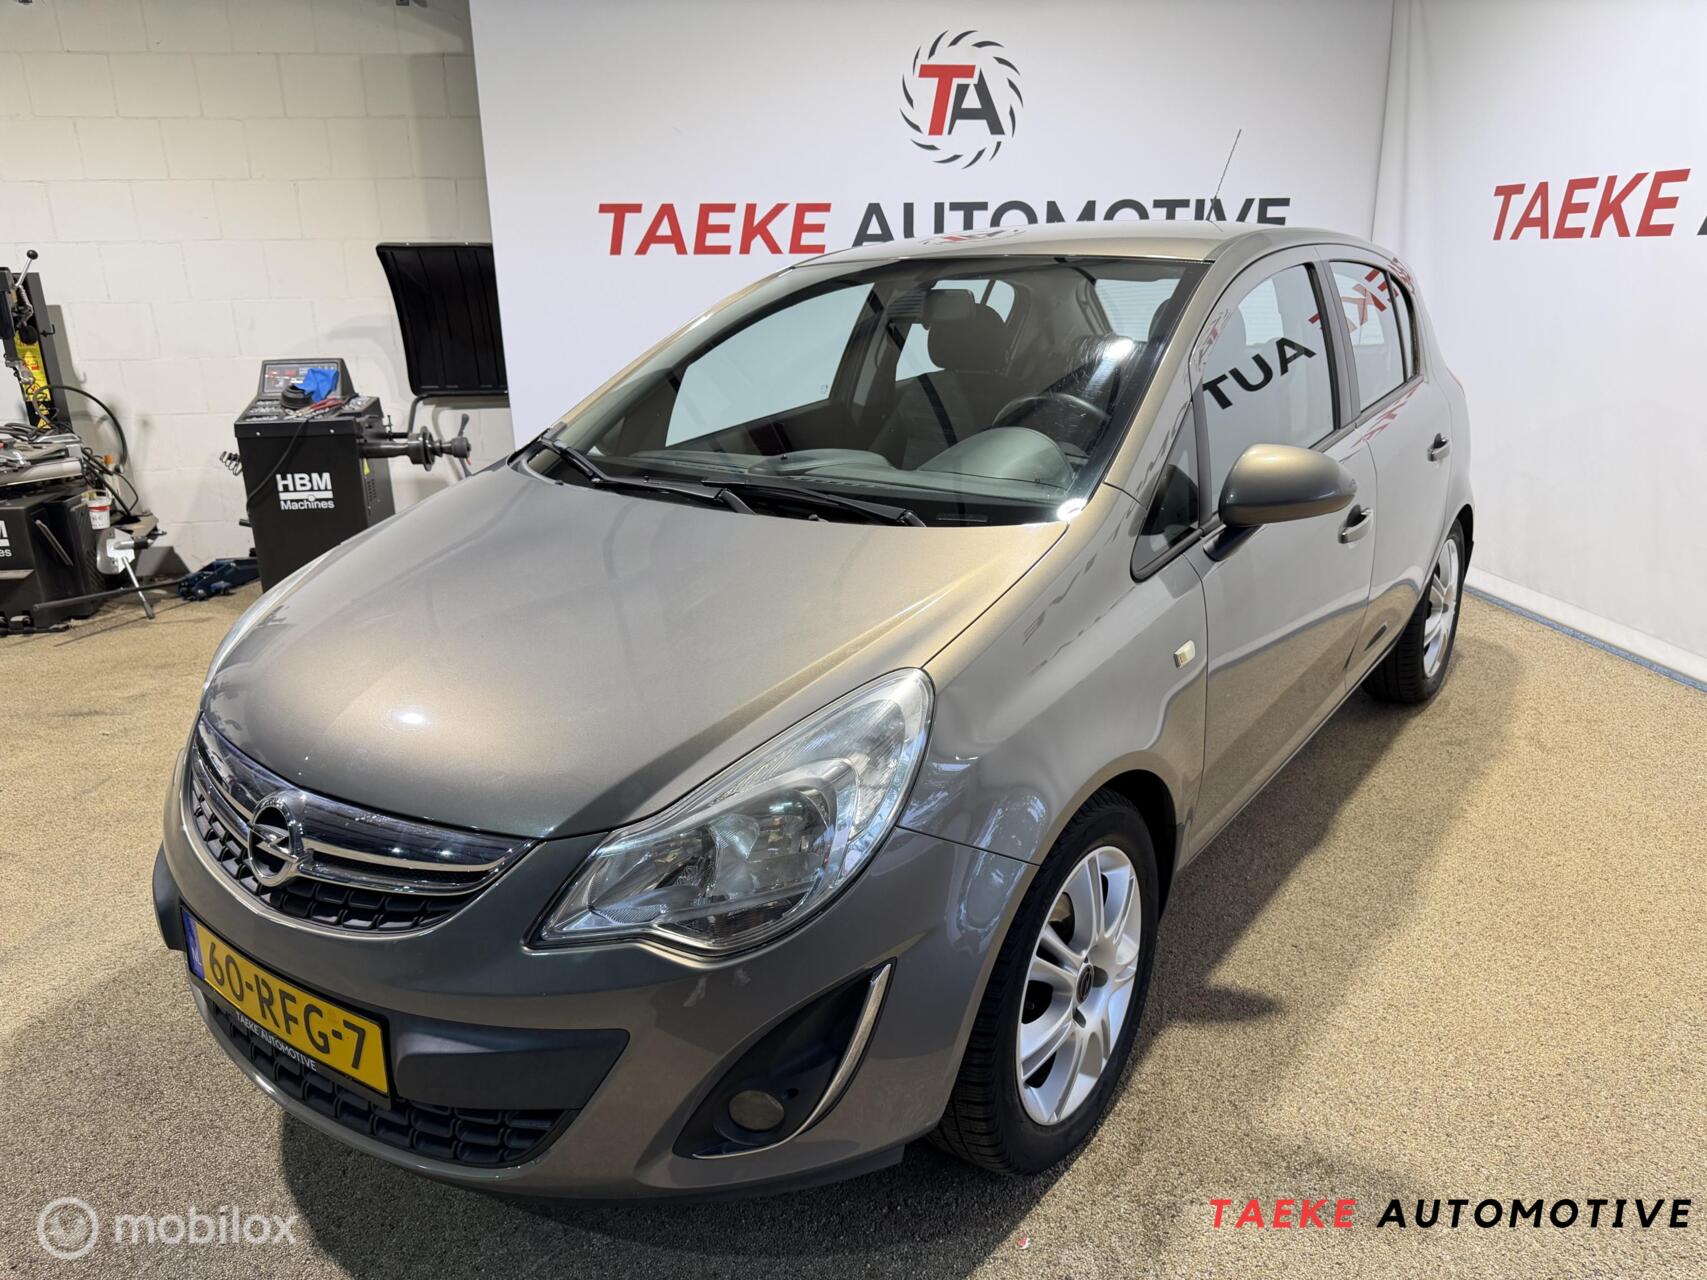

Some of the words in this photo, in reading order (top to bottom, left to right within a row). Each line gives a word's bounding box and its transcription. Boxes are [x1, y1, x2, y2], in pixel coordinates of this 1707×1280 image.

[918, 64, 1005, 136] TA
[598, 203, 832, 255] TAEKE
[1492, 168, 1691, 241] TAEKE
[276, 473, 332, 491] HBM
[281, 500, 335, 511] Machines
[208, 942, 367, 1070] 60-RFG-7
[236, 1010, 260, 1036] TAEKE
[261, 1029, 317, 1072] AUTOMOTIVE
